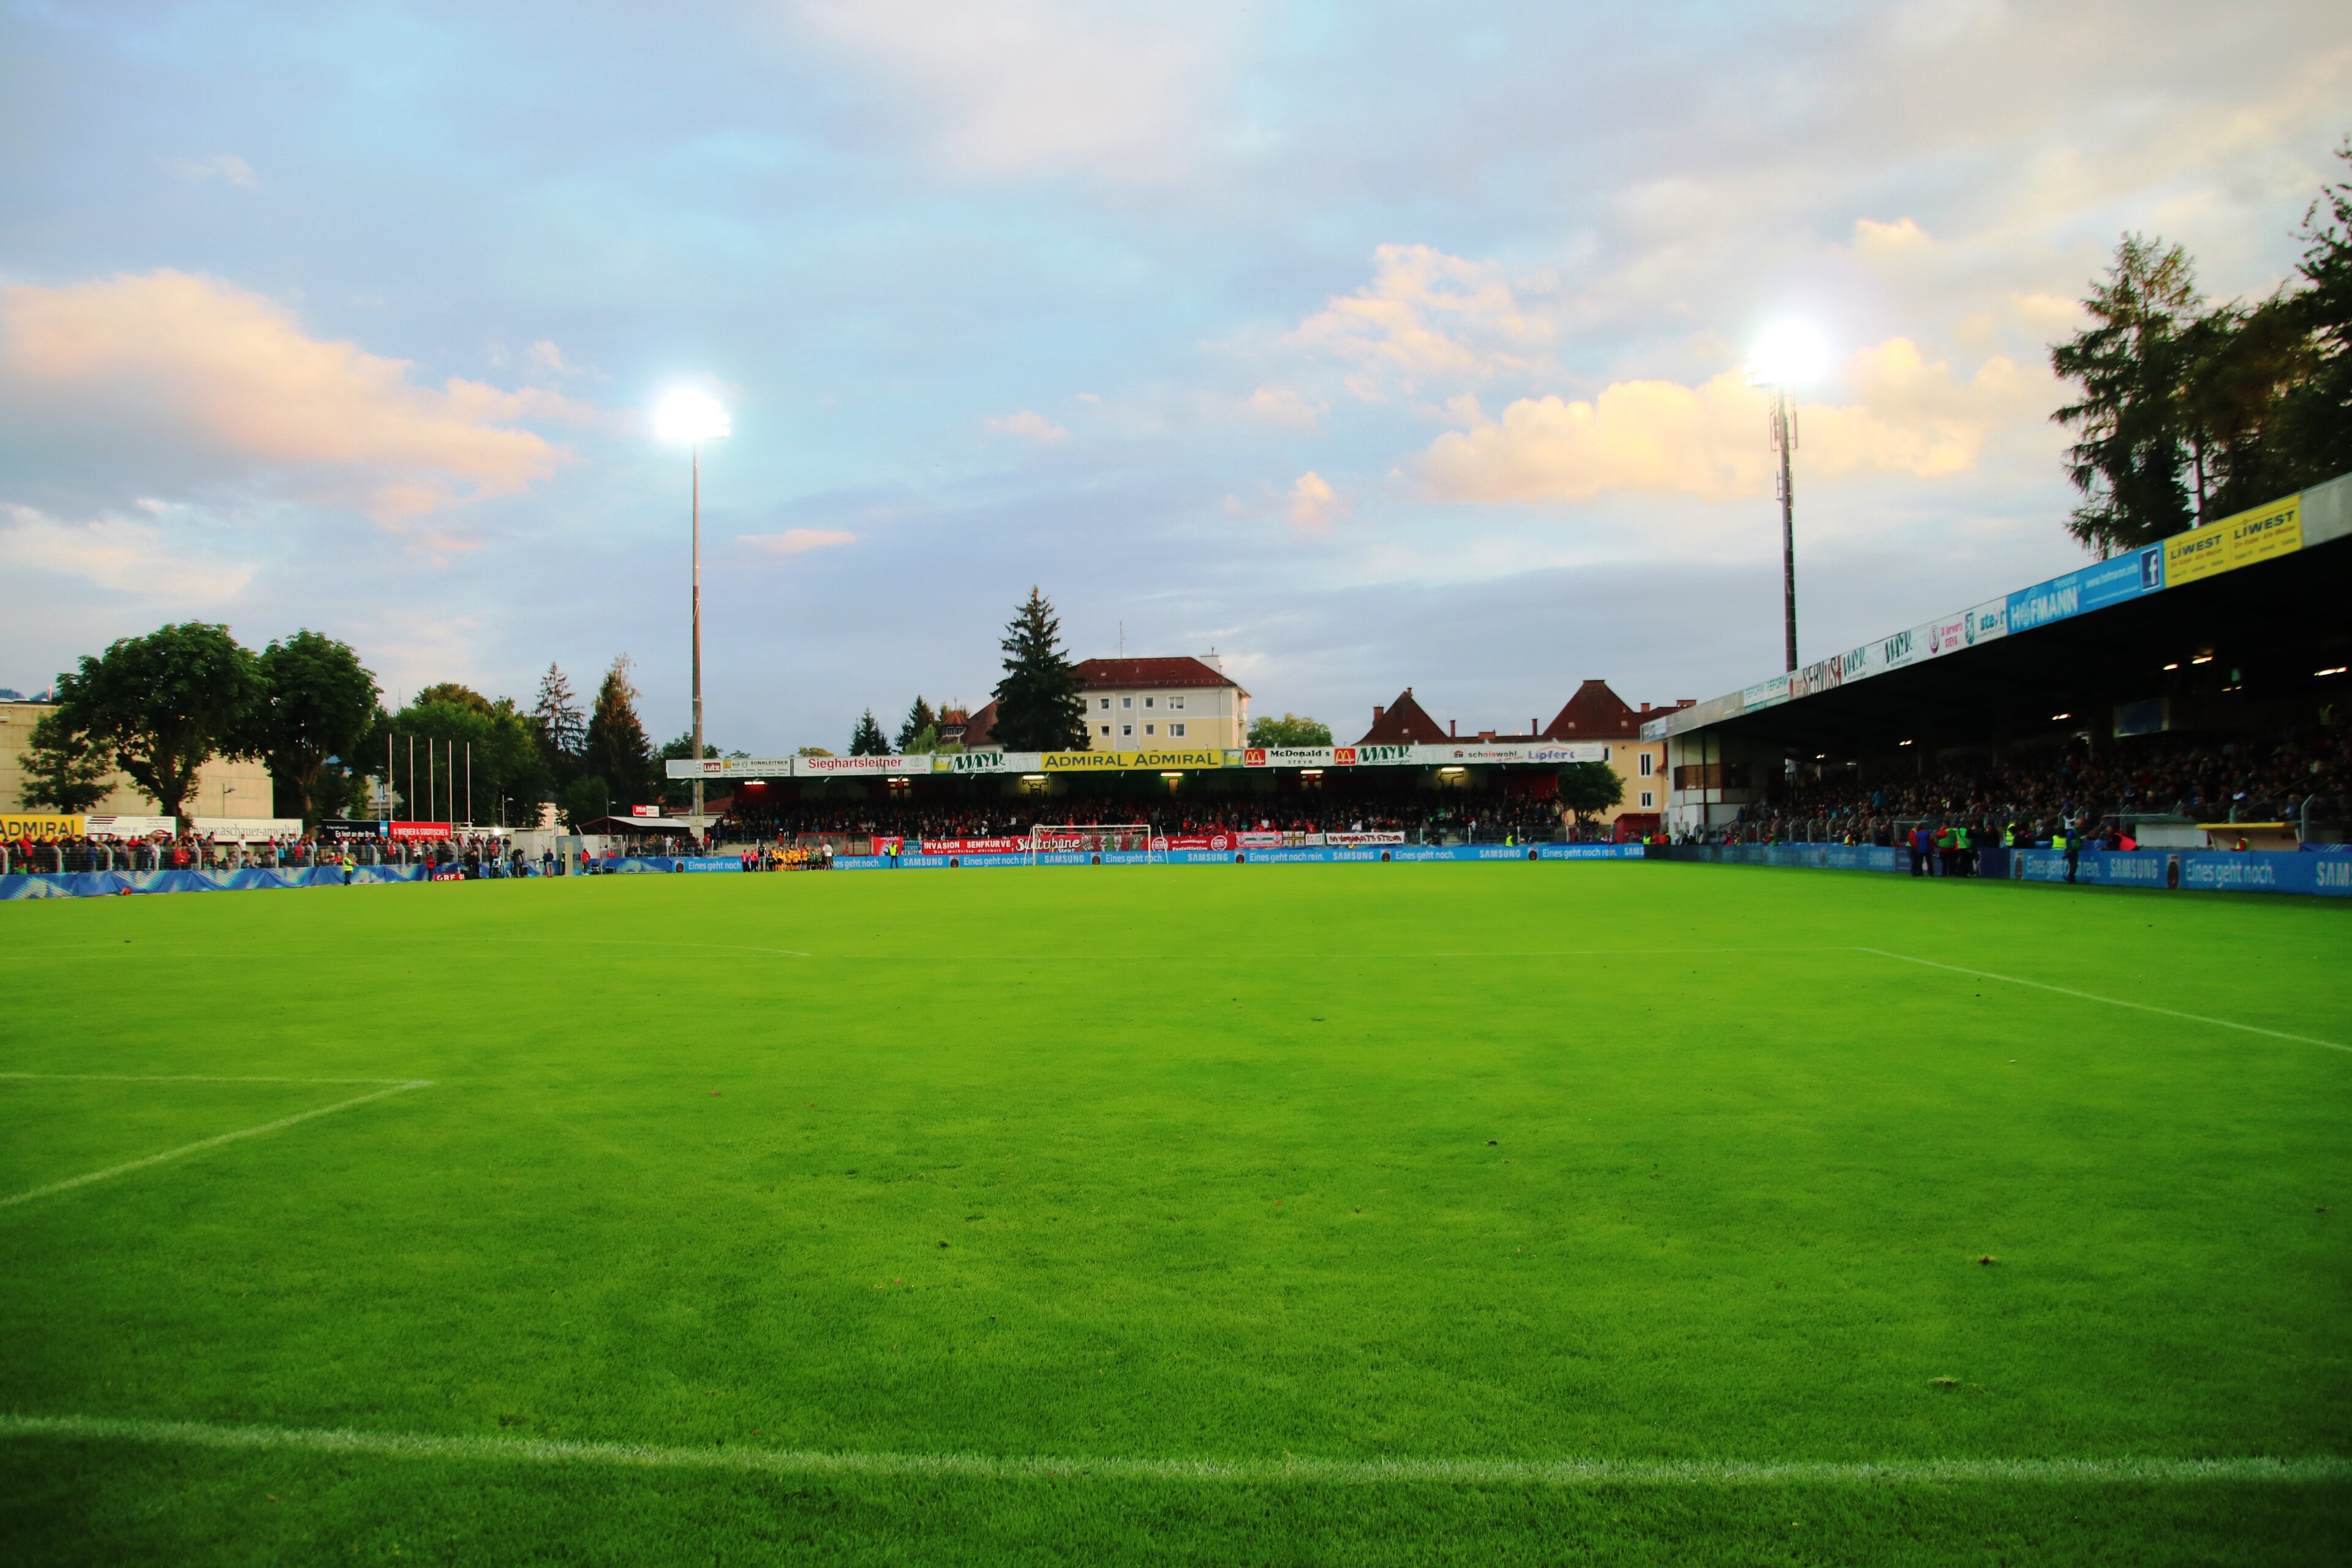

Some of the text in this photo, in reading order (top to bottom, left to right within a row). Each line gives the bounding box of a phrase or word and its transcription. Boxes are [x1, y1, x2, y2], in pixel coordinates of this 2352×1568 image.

[2234, 511, 2294, 540] LIWEST
[2170, 535, 2222, 560] LIWEST
[2010, 586, 2078, 630] HOFMANN
[1885, 631, 1912, 665] MAYR
[1357, 746, 1411, 762] MAYR
[1528, 750, 1575, 761] Lipfert
[808, 757, 902, 771] Sieghartsleitner
[954, 753, 1006, 770] MAYR
[1044, 753, 1218, 768] ADMIRAL ADMIRAL
[704, 763, 720, 772] Lutz
[398, 827, 416, 836] WIENER
[967, 840, 1011, 848] SENFKURVE
[1106, 853, 1164, 864] Eines geht noch.
[1188, 853, 1228, 861] SAMSUNG
[1250, 852, 1324, 863] Eines geht noch rein.
[1333, 851, 1374, 860] SAMSUNG
[1395, 850, 1455, 861] Eines geht noch.
[1479, 850, 1521, 858] SAMSUNG
[1542, 849, 1562, 858] Eines
[1564, 848, 1581, 859] geht
[1582, 848, 1600, 856] noch
[845, 859, 861, 870] geht
[862, 859, 881, 868] noch.
[963, 857, 983, 865] Eines
[984, 856, 1000, 867] geht
[1001, 856, 1019, 864] noch
[1044, 855, 1084, 864] SAMSUNG
[688, 860, 741, 872] Eines geht noch
[2110, 859, 2158, 878] SAMSUNG
[2186, 858, 2275, 888] Eines geht noch.
[2316, 862, 2352, 887] SAM
